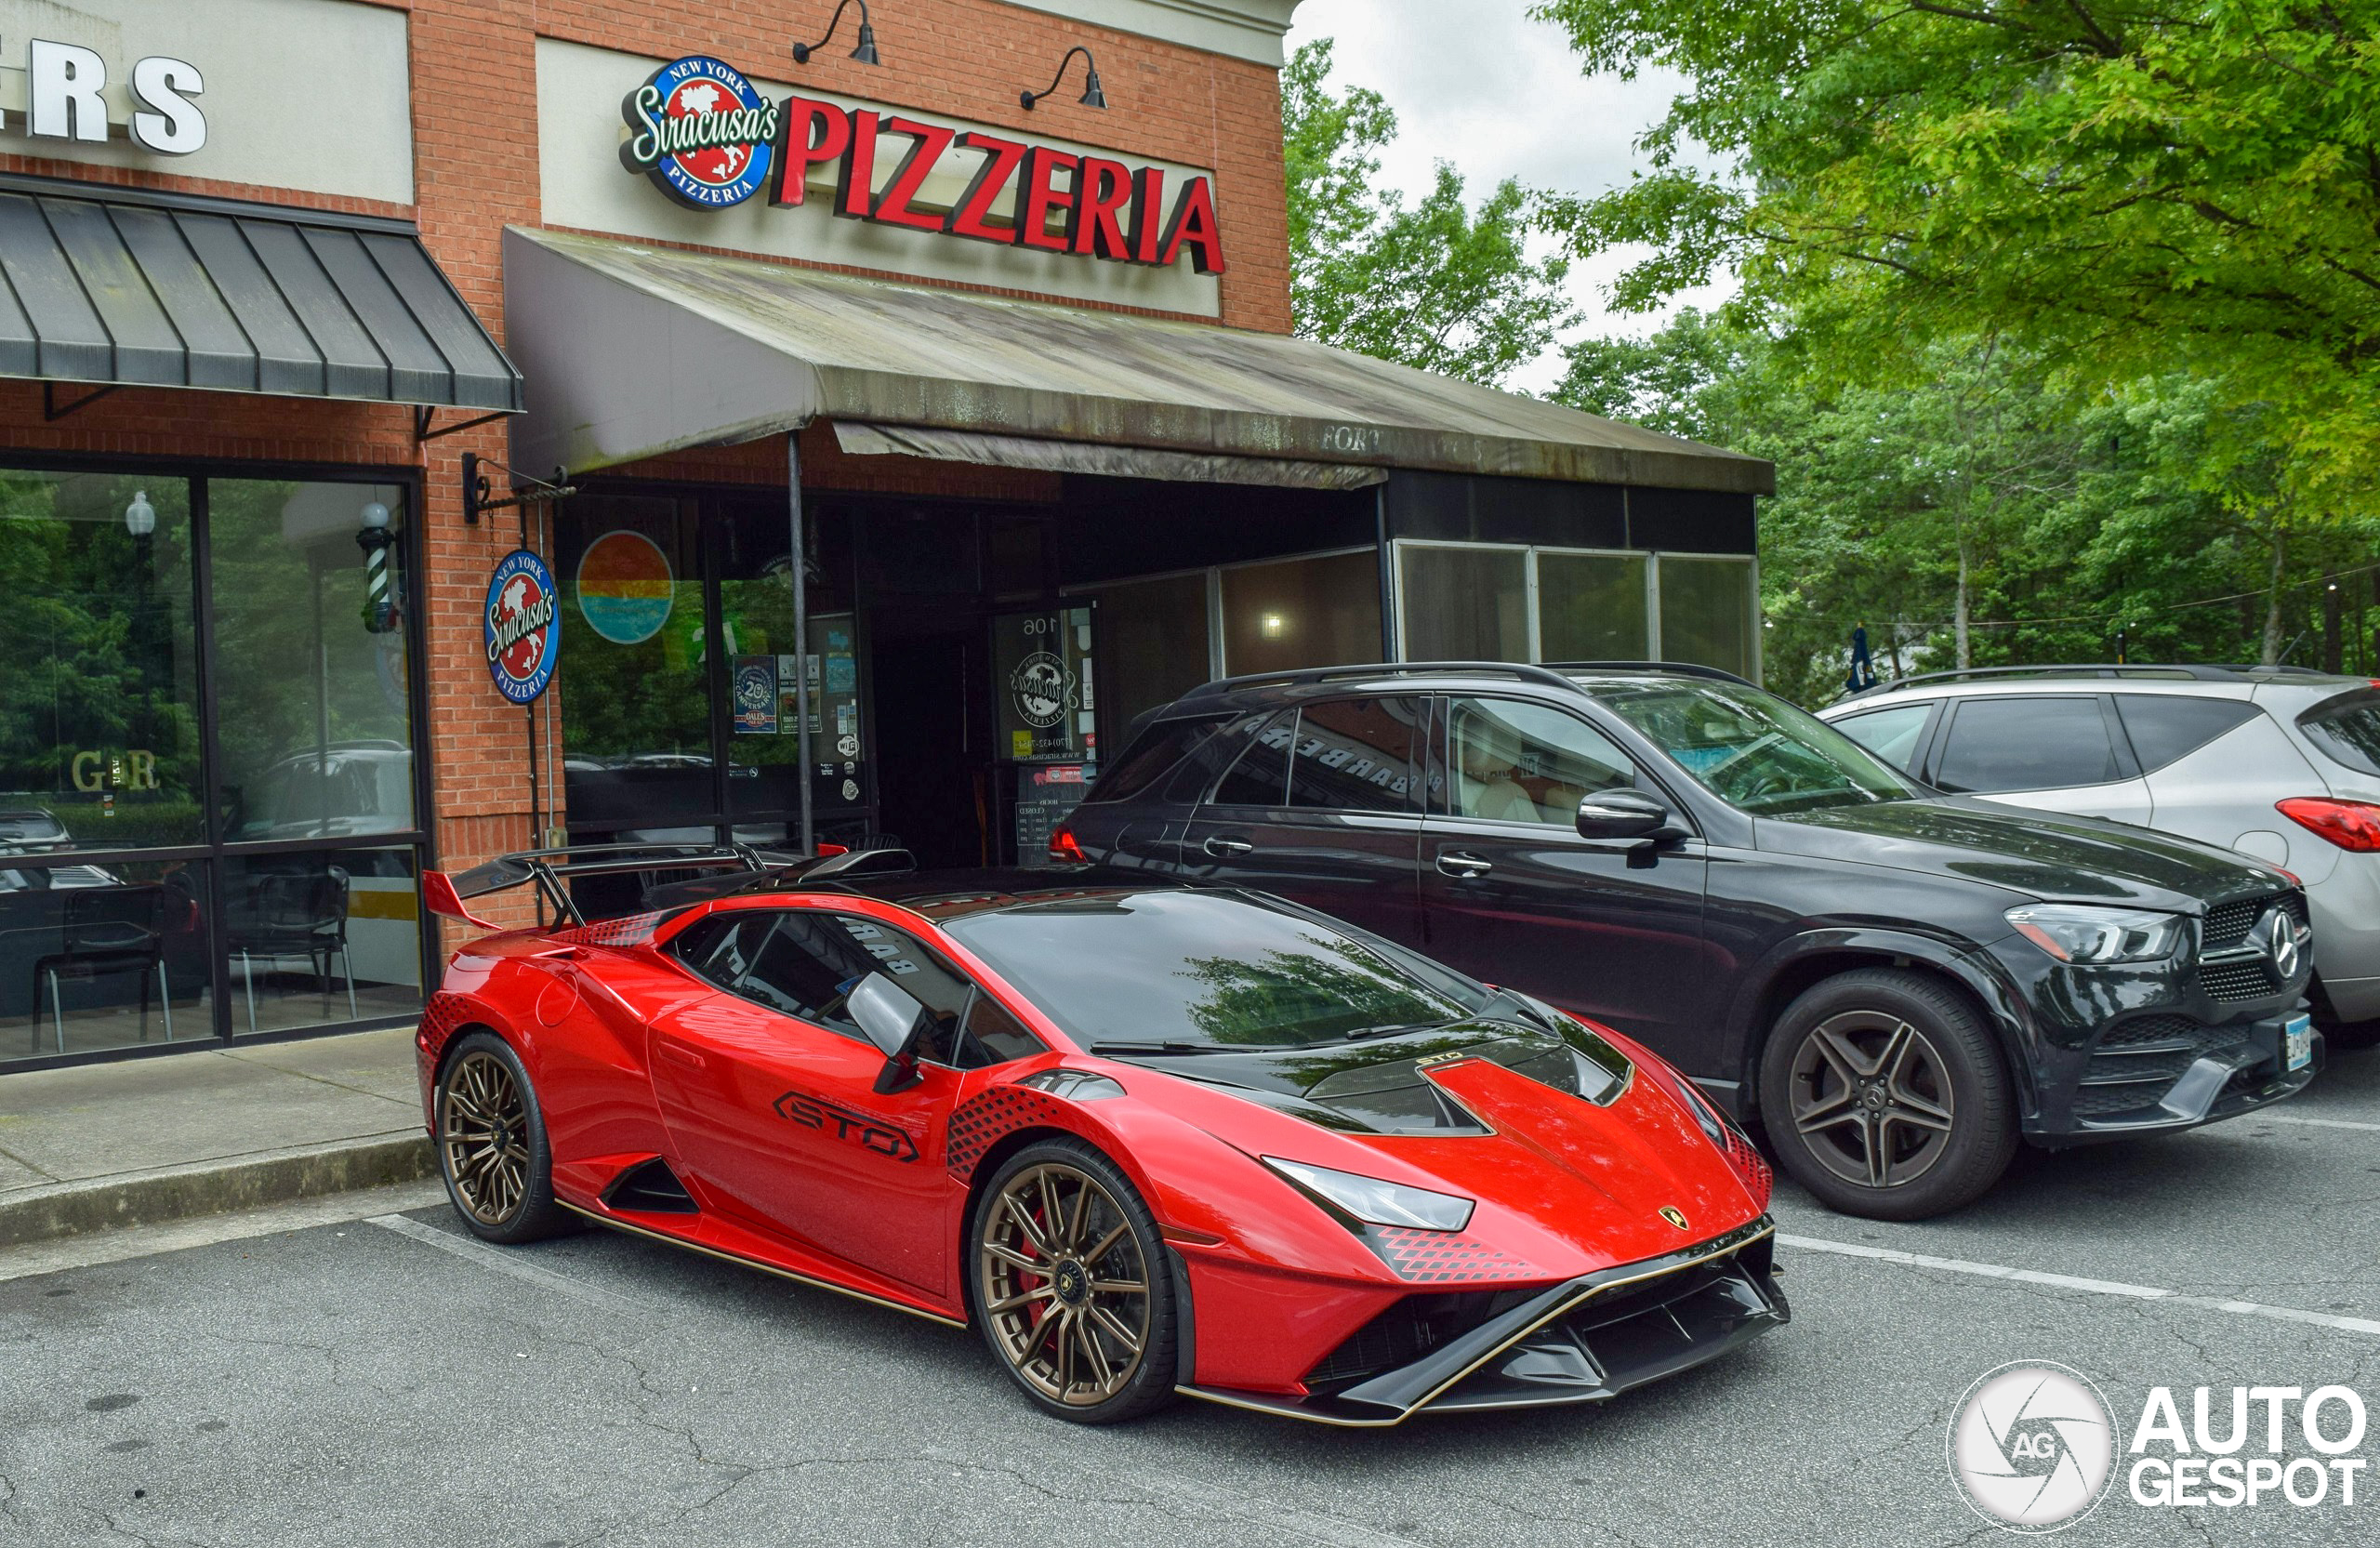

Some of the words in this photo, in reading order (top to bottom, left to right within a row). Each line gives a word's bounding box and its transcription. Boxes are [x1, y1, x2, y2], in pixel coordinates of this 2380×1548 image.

[0, 38, 207, 156] RS
[669, 60, 702, 82] NEW
[706, 62, 747, 96] YORK
[633, 85, 778, 163] Siracusa's
[668, 165, 753, 203] PIZZERIA
[772, 97, 1225, 276] PIZZERIA
[497, 562, 516, 586] NEW
[518, 556, 544, 581] YORK
[488, 588, 554, 662] Siracusa's
[497, 668, 548, 698] PIZZERIA
[744, 681, 763, 699] 20
[1416, 1052, 1463, 1065] STO
[791, 1102, 901, 1158] STO
